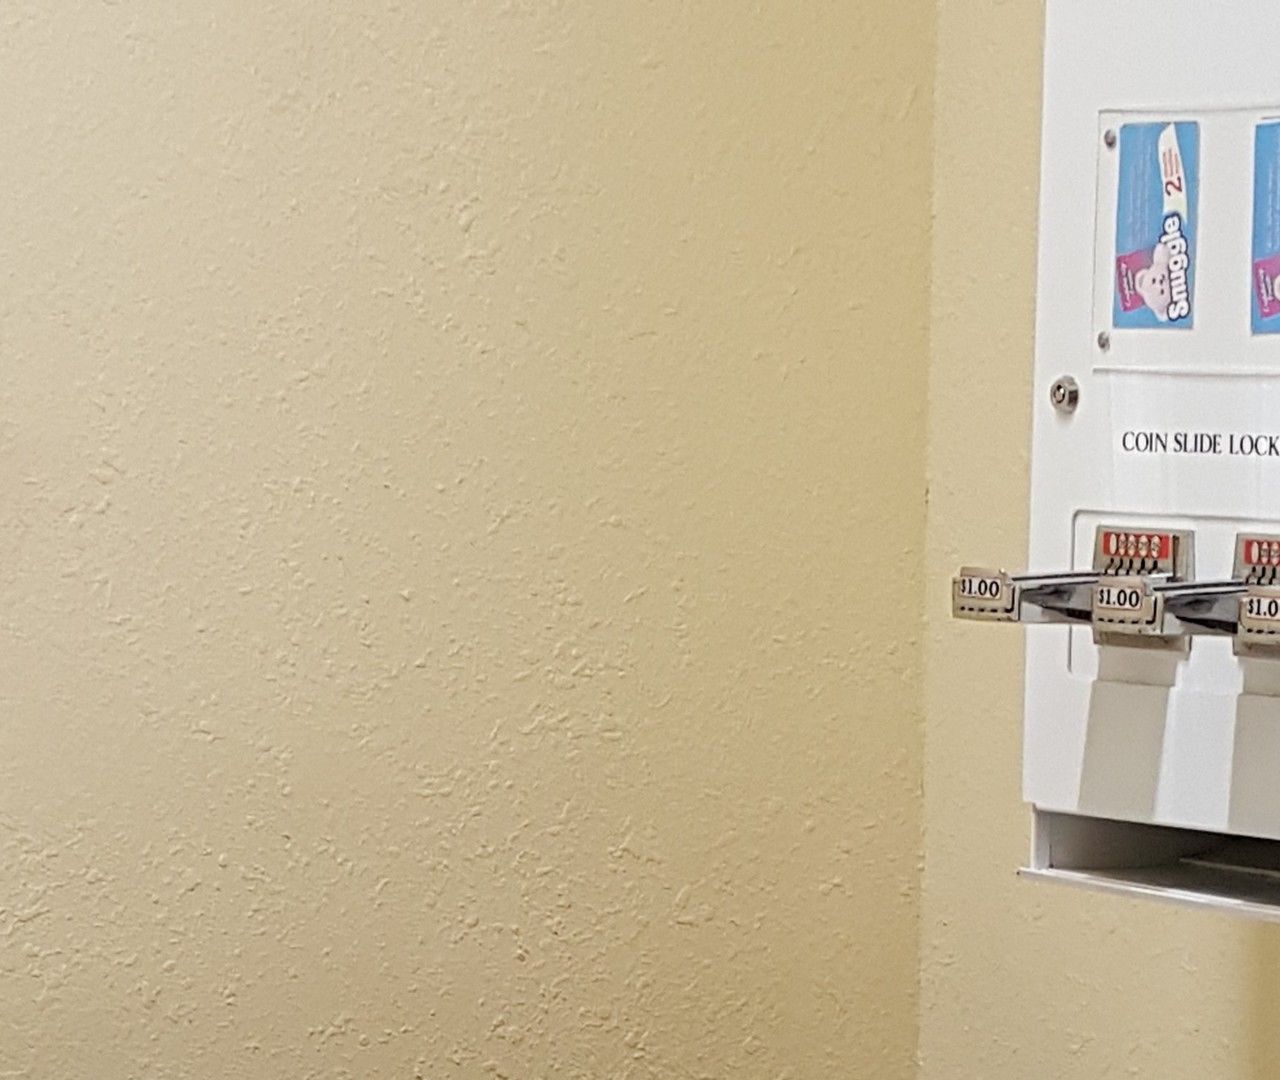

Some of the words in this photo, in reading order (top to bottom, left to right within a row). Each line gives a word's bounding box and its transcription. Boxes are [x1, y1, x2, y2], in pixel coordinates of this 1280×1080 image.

[1164, 176, 1182, 197] 2
[1160, 214, 1190, 320] Snuggle
[1122, 431, 1168, 453] COIN
[1173, 432, 1222, 454] SLIDE
[960, 578, 1000, 598] $1.00
[1099, 588, 1140, 608] $1.00
